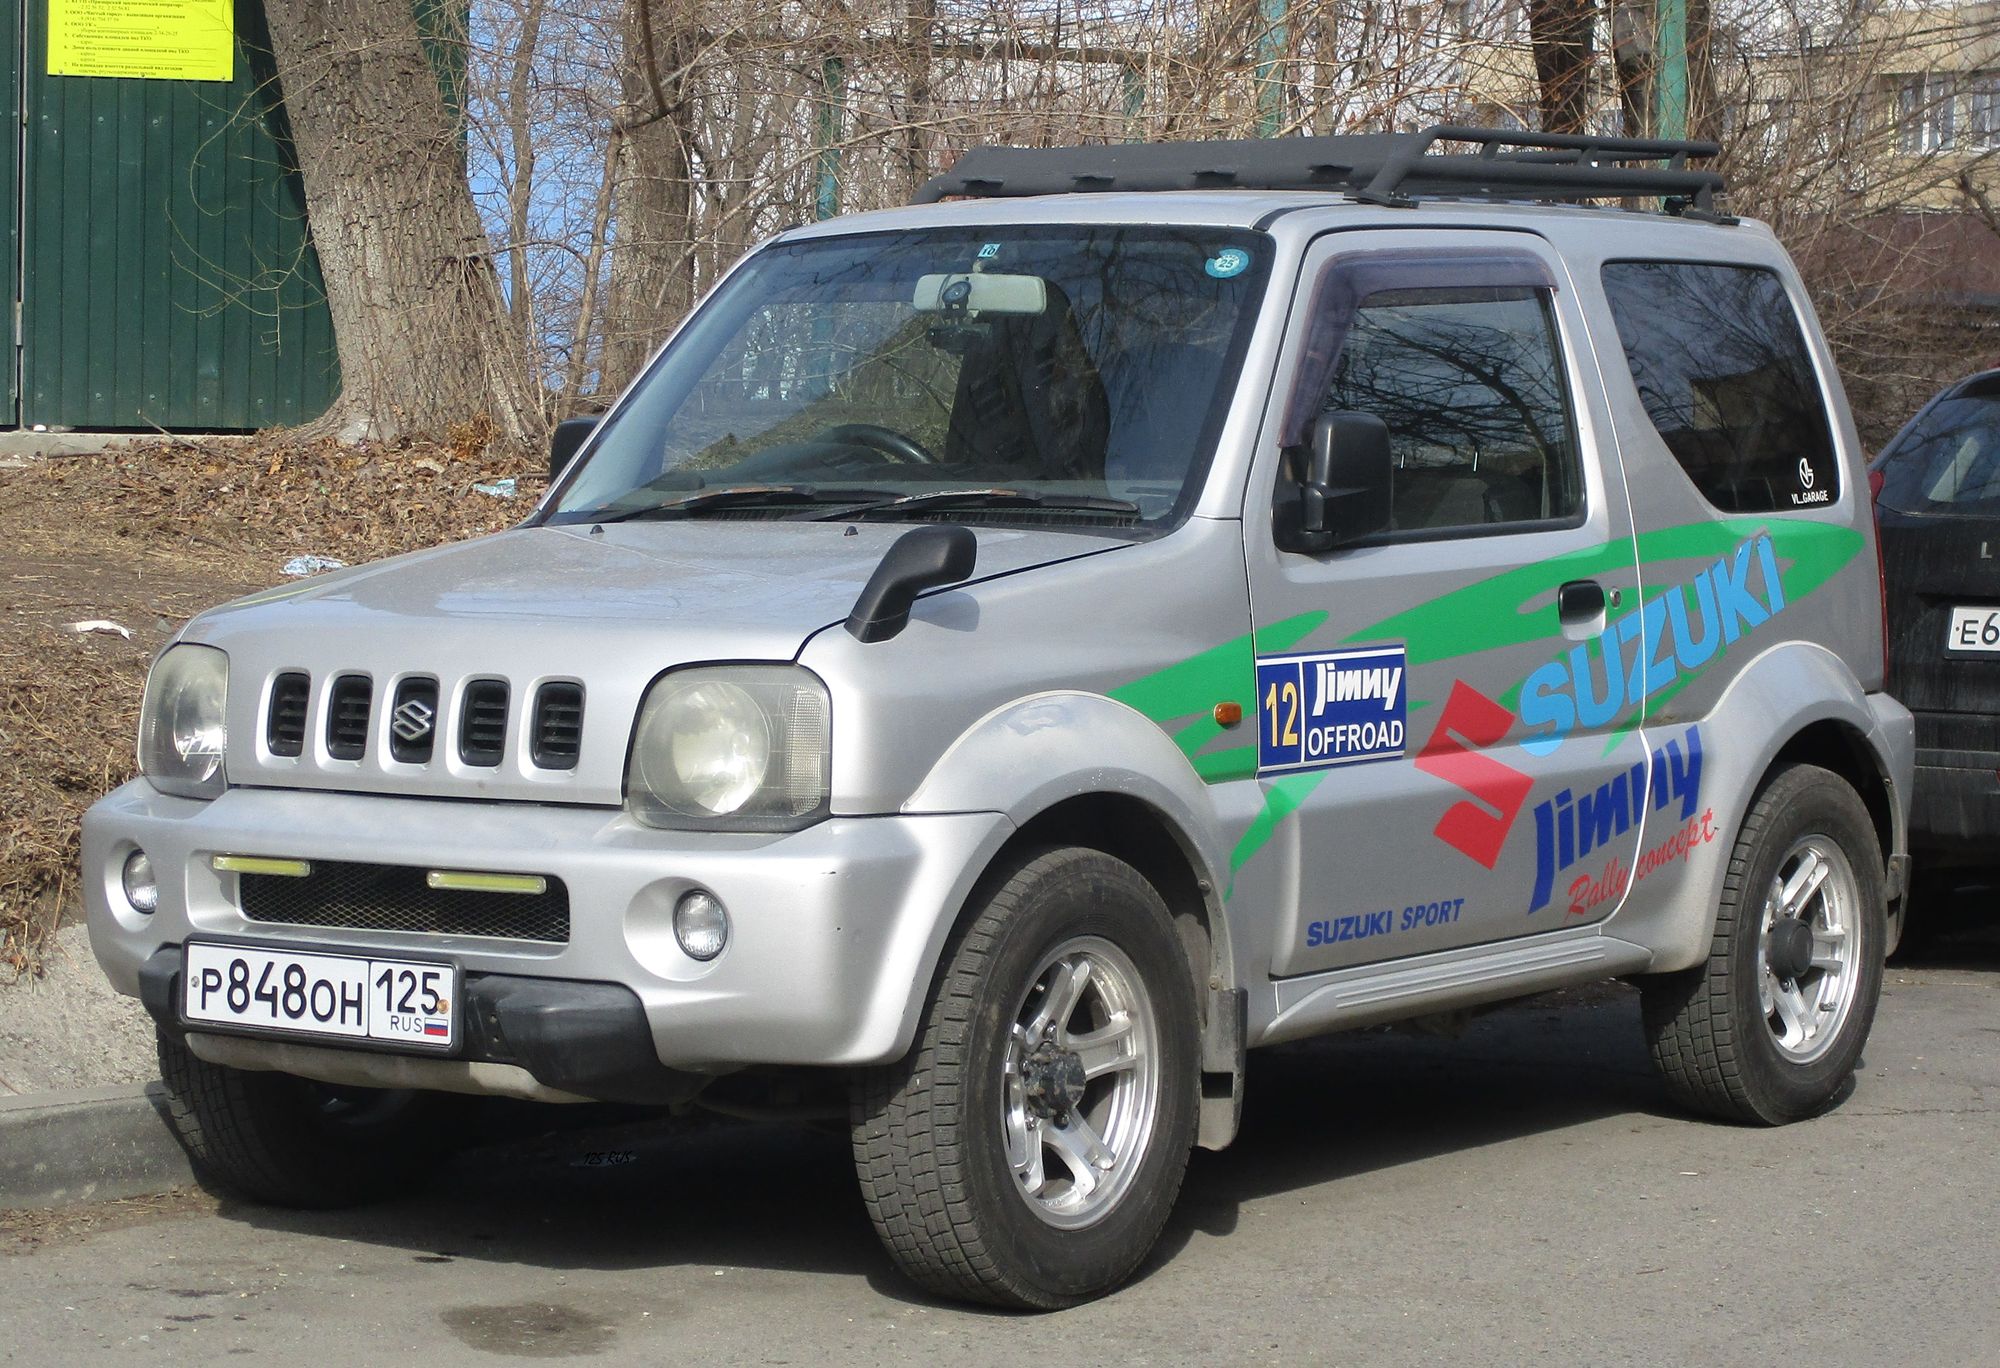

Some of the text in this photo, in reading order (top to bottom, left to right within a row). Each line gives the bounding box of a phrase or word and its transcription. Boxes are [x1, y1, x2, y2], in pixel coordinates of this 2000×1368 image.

[1218, 258, 1235, 268] 25
[1520, 534, 1784, 757] SUZUKI
[1266, 681, 1298, 747] 12
[1312, 662, 1403, 717] Jimny
[1307, 720, 1404, 756] OFFROAD
[1528, 725, 1703, 915] Jimny
[1563, 808, 1719, 926] Rally concept
[1306, 898, 1465, 947] SUZUKI SPORT
[376, 968, 441, 1016] 125
[390, 1015, 423, 1033] RUS
